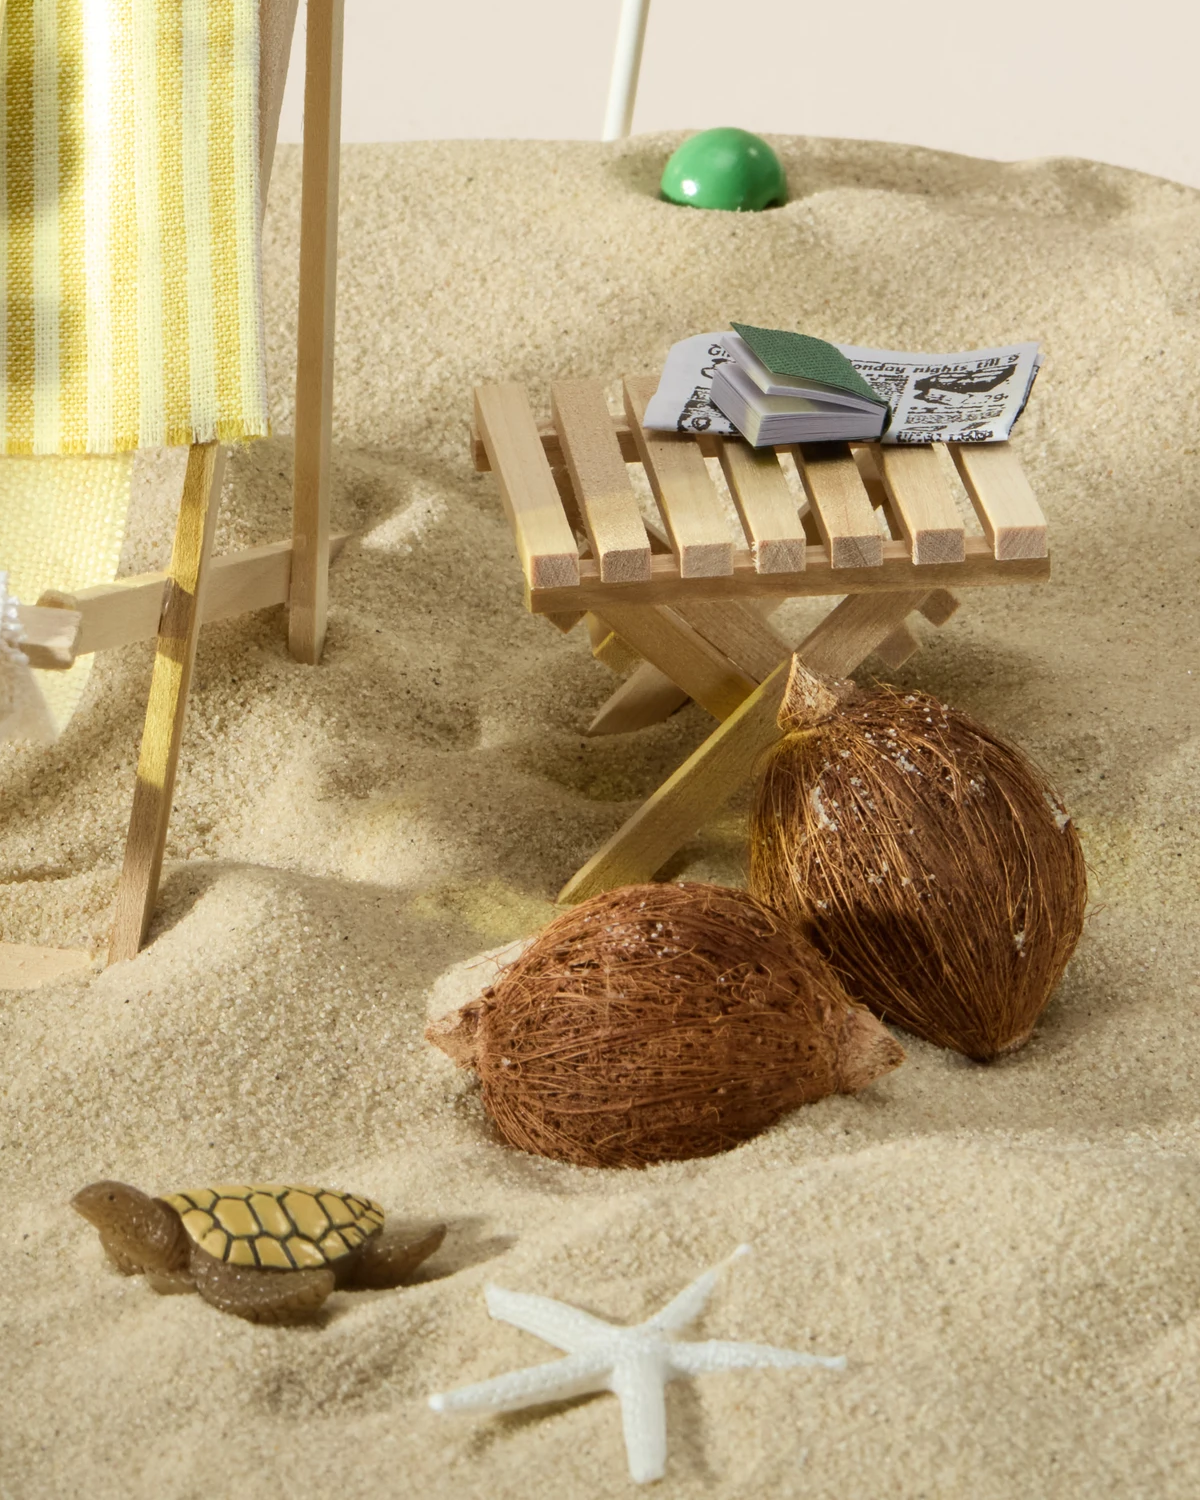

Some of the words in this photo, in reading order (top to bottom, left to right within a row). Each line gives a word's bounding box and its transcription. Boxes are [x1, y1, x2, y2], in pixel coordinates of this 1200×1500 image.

[853, 363, 907, 375] onday
[912, 363, 969, 375] nights
[976, 357, 1001, 369] till
